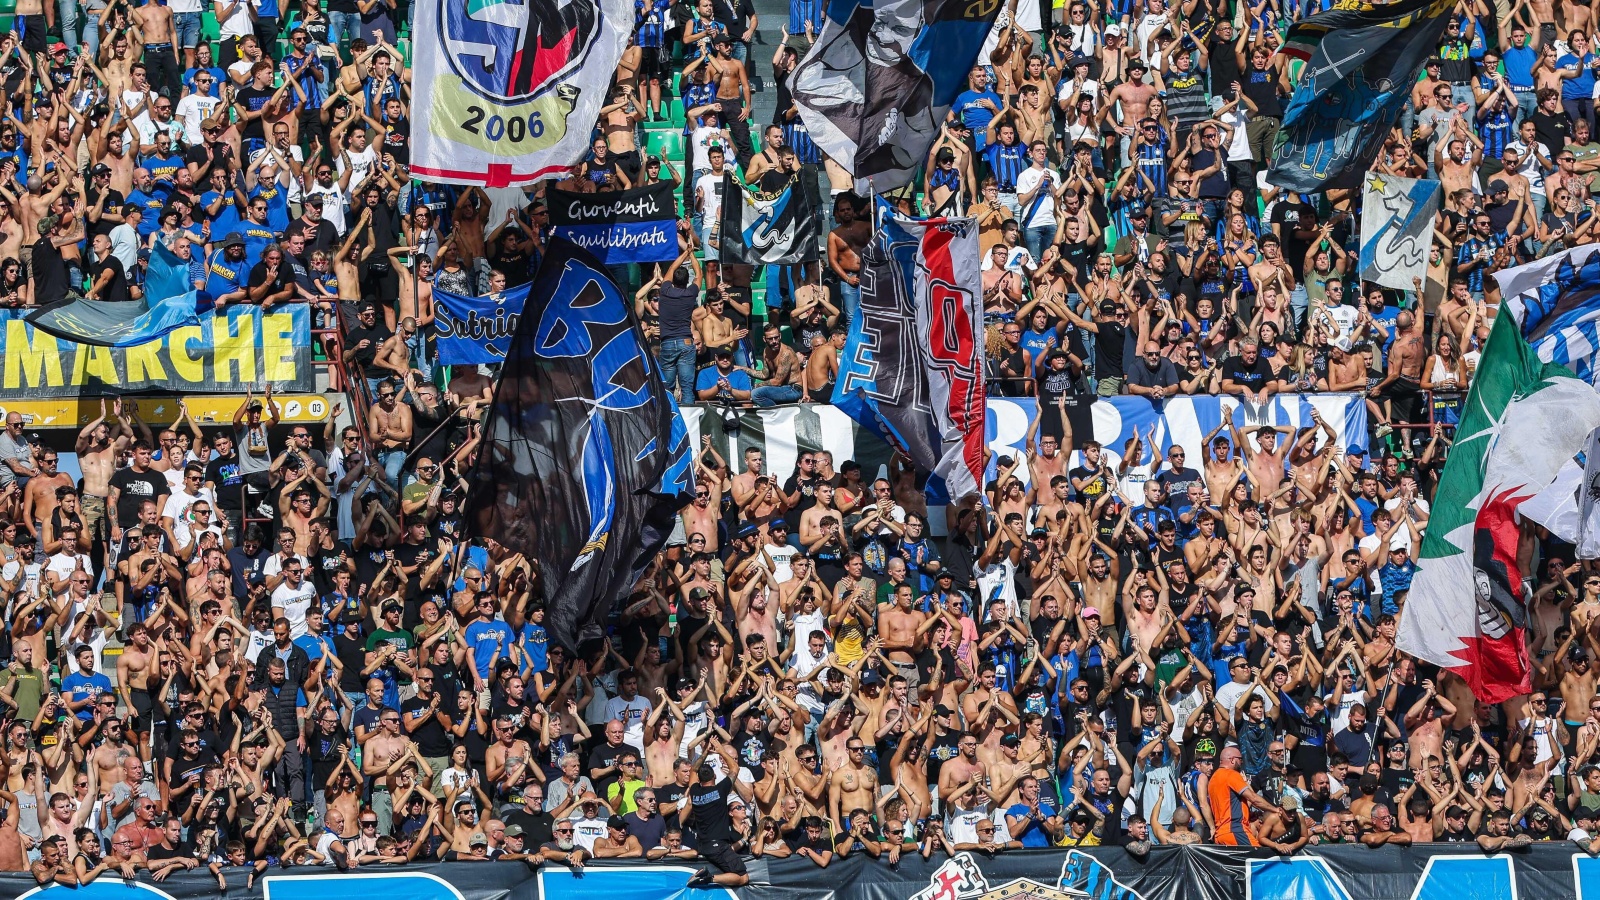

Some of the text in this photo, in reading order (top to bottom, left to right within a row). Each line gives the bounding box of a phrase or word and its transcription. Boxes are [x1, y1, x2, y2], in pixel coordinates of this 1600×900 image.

[461, 105, 545, 143] 2006
[567, 194, 660, 221] Gioventù
[3, 312, 297, 390] MARCHE
[312, 403, 322, 413] 03
